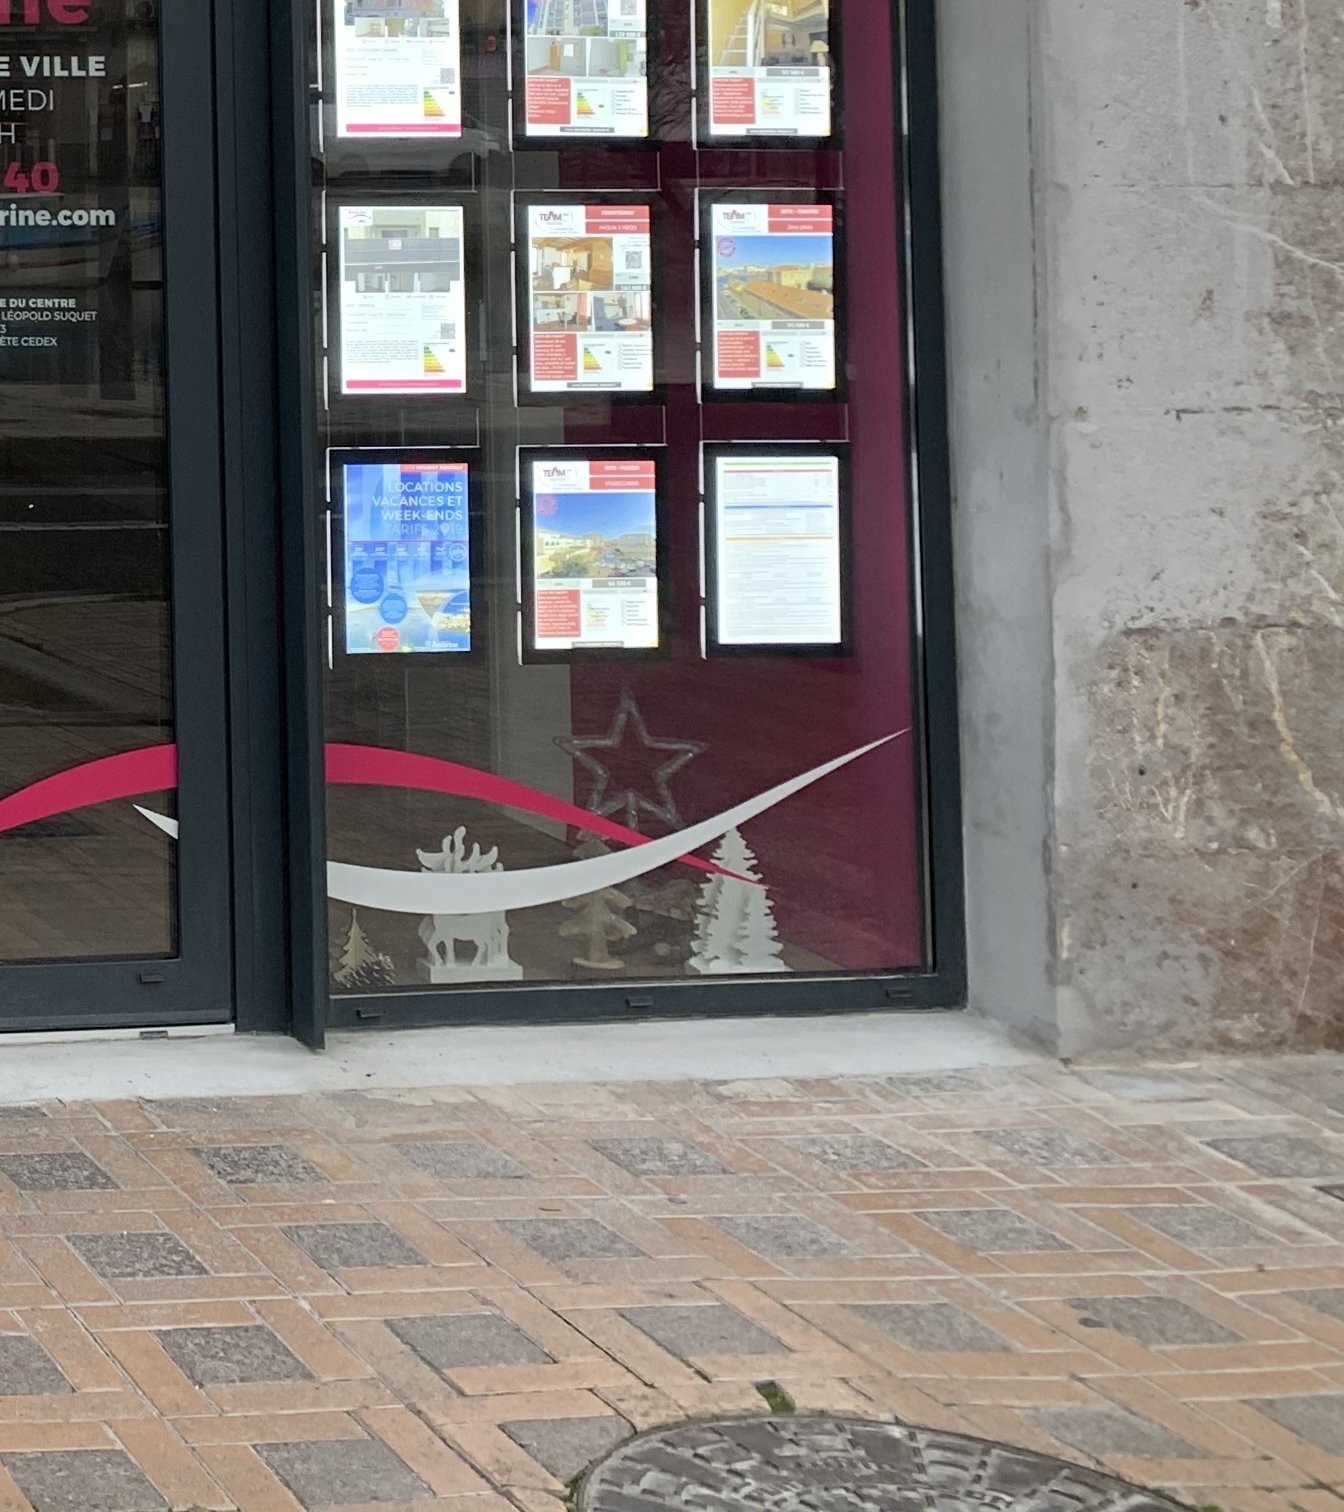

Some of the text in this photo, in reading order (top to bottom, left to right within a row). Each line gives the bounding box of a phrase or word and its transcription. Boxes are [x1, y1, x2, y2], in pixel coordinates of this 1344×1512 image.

[19, 54, 107, 78] VILLE
[3, 161, 59, 195] 40
[9, 298, 26, 308] DU
[28, 298, 76, 308] CENTRE
[2, 309, 51, 322] LÉOPOLD
[54, 311, 98, 321] SUQUET
[21, 337, 58, 347] CEDEX
[388, 481, 463, 493] LOCATIONS
[372, 495, 463, 507] VACANCES ET
[381, 510, 463, 521] WEEK-ENDS
